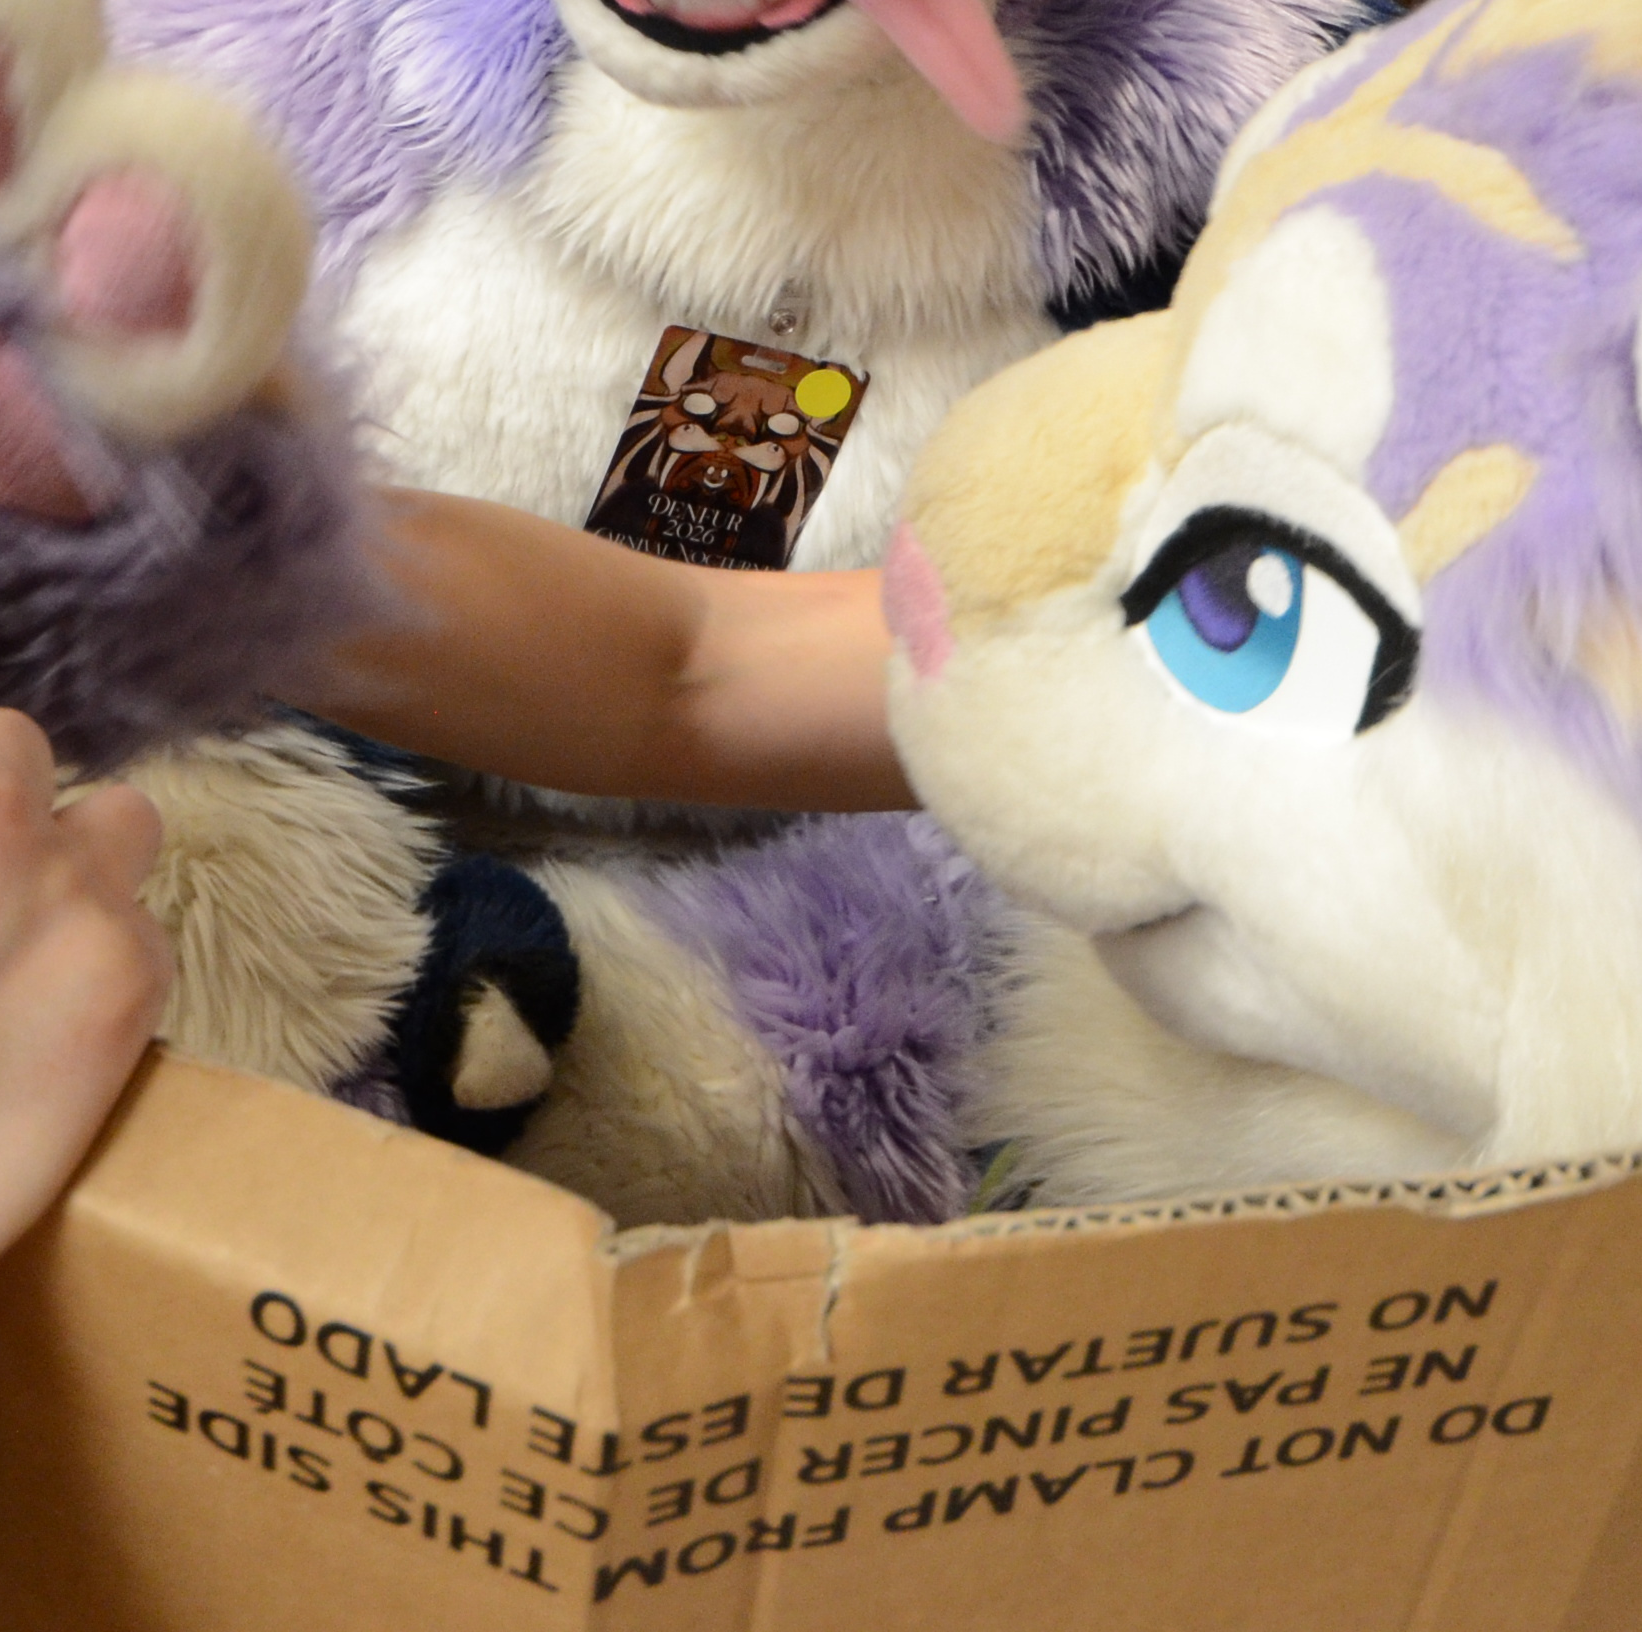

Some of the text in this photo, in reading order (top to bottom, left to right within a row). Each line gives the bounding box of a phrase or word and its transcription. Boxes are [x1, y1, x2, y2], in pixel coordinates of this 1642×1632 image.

[648, 493, 743, 532] DENFUR
[662, 519, 716, 545] 2026
[243, 1344, 1479, 1542] NE PAS PINCER DE CE CÔTÉ
[249, 1278, 1499, 1478] NO SUJETAR DE ESTE LADO
[147, 1379, 1554, 1605] DO NOT CLAMP FROM THIS SIDE
